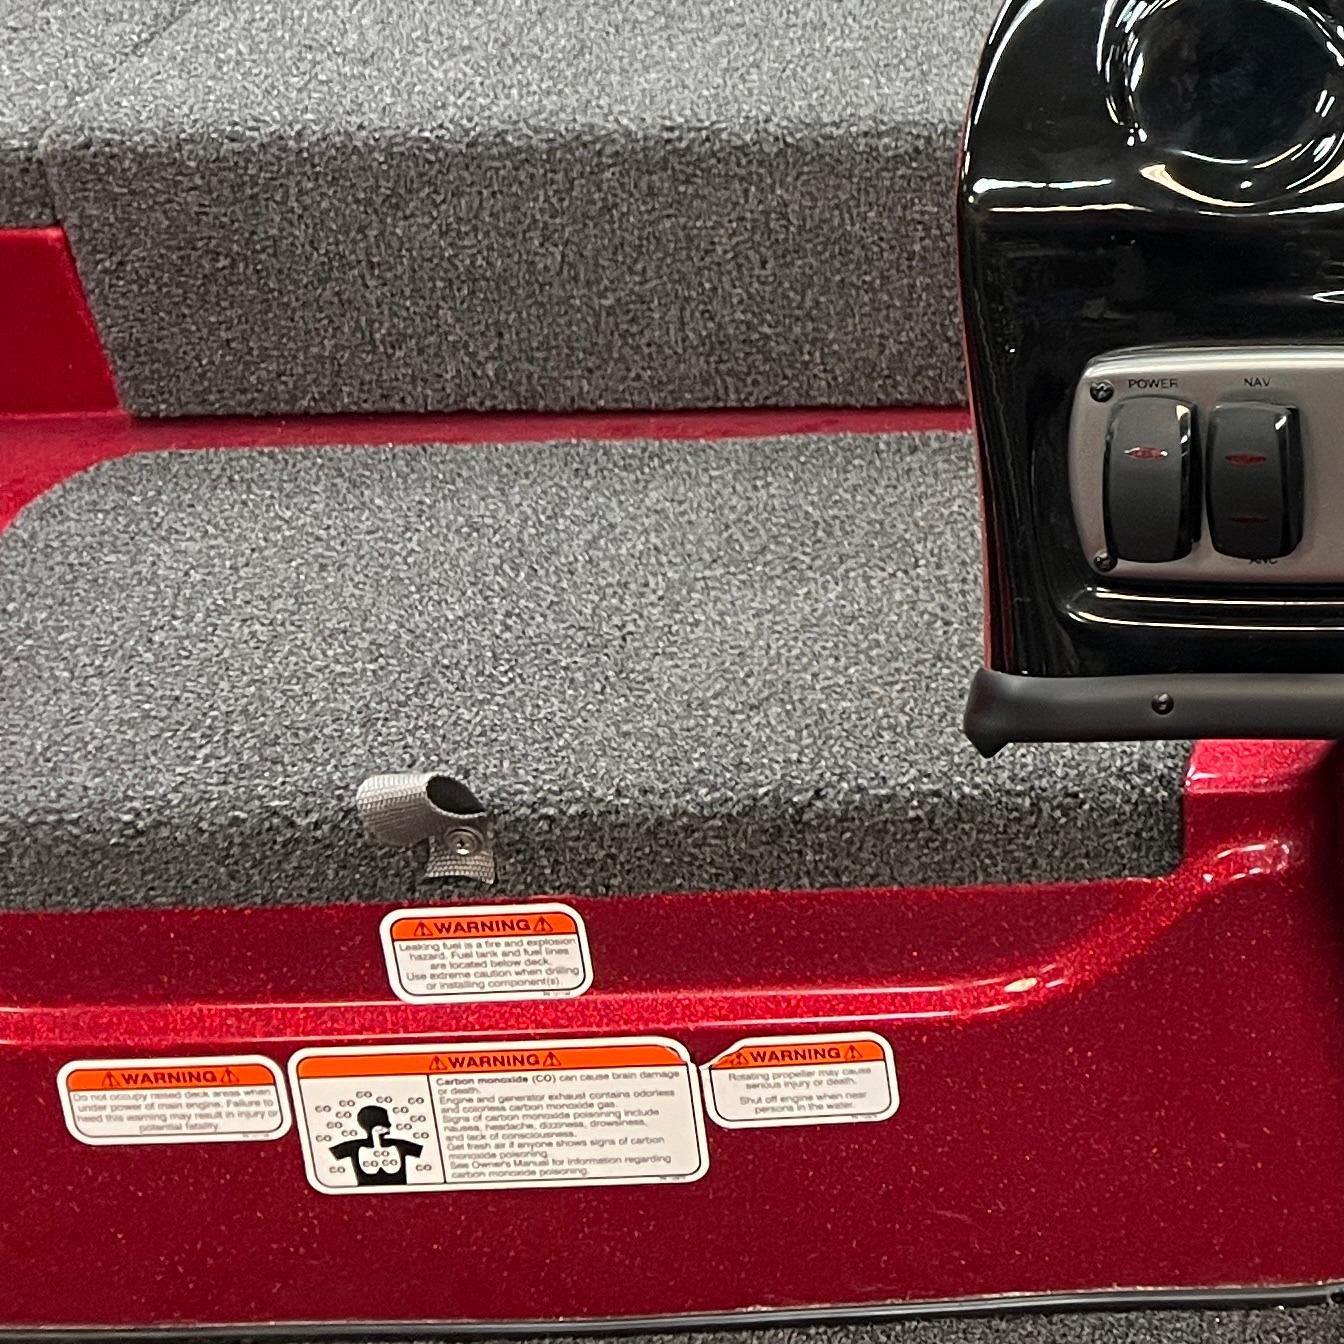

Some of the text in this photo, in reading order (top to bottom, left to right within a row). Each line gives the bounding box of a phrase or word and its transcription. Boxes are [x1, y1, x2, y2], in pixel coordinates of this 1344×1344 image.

[1128, 378, 1179, 389] POWER
[1244, 377, 1271, 388] NAV
[433, 918, 530, 934] WARNING
[399, 942, 440, 952] Leaking
[503, 938, 523, 946] and
[526, 935, 575, 946] explosion
[409, 952, 447, 960] hazard.
[500, 948, 520, 956] and
[523, 947, 542, 955] fuel
[544, 946, 569, 954] lines
[449, 960, 487, 969] located
[490, 959, 521, 967] below
[523, 957, 551, 965] deck.
[406, 966, 580, 980] Use extreme caution when drilling
[439, 980, 485, 990] installing
[448, 1054, 540, 1068] WARNING
[750, 1048, 840, 1063] WARNING
[121, 1071, 217, 1085] WARNING
[436, 1077, 474, 1085] Carbon
[477, 1075, 528, 1084] monoxide
[531, 1074, 557, 1084] (CO)
[611, 1071, 636, 1079] brain
[639, 1070, 679, 1080] damage
